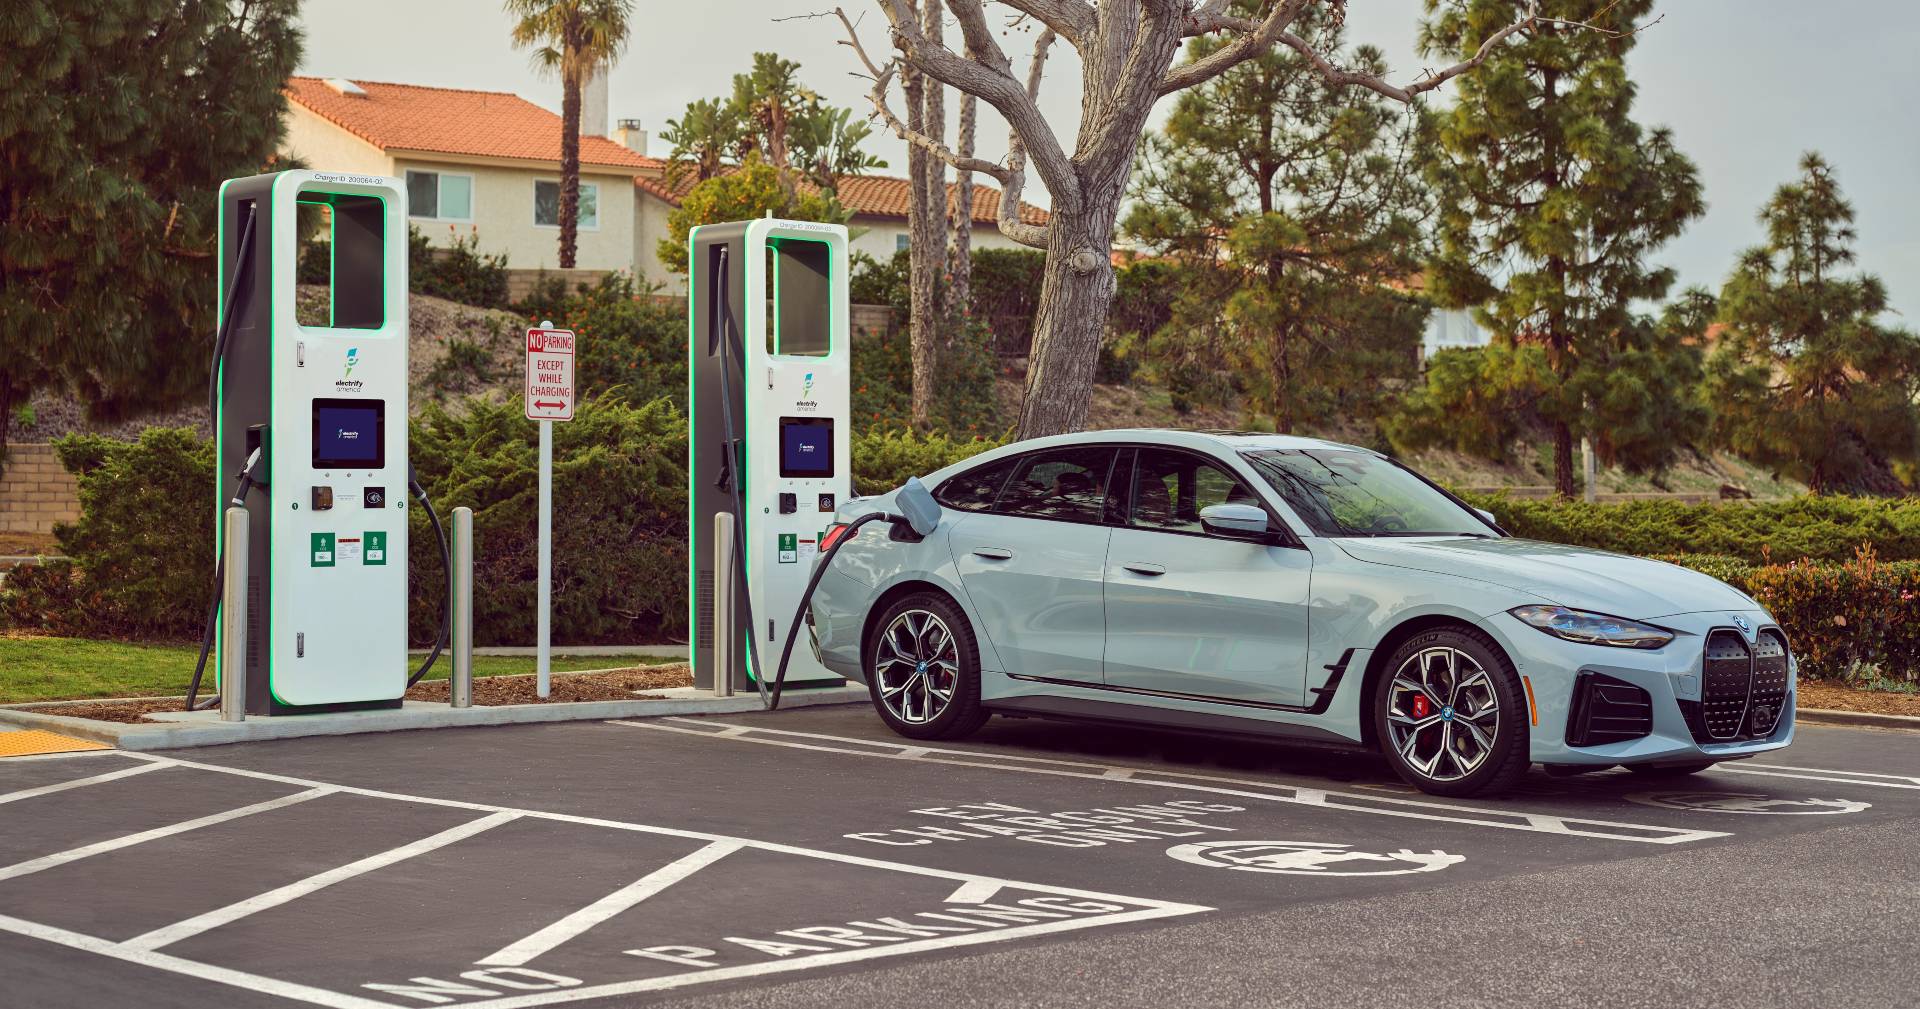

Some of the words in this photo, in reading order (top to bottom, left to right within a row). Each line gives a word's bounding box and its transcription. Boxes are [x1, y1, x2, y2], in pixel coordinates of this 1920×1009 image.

[314, 173, 338, 183] Charger
[529, 333, 543, 349] NO
[543, 335, 572, 350] PARKING
[537, 359, 564, 371] EXCEPT
[538, 373, 563, 384] WHILE
[530, 386, 570, 397] CHARGING
[842, 800, 1246, 846] CHARGING
[1014, 817, 1239, 848] ONLY
[360, 966, 583, 1004] NO
[621, 897, 1125, 968] PARKING
